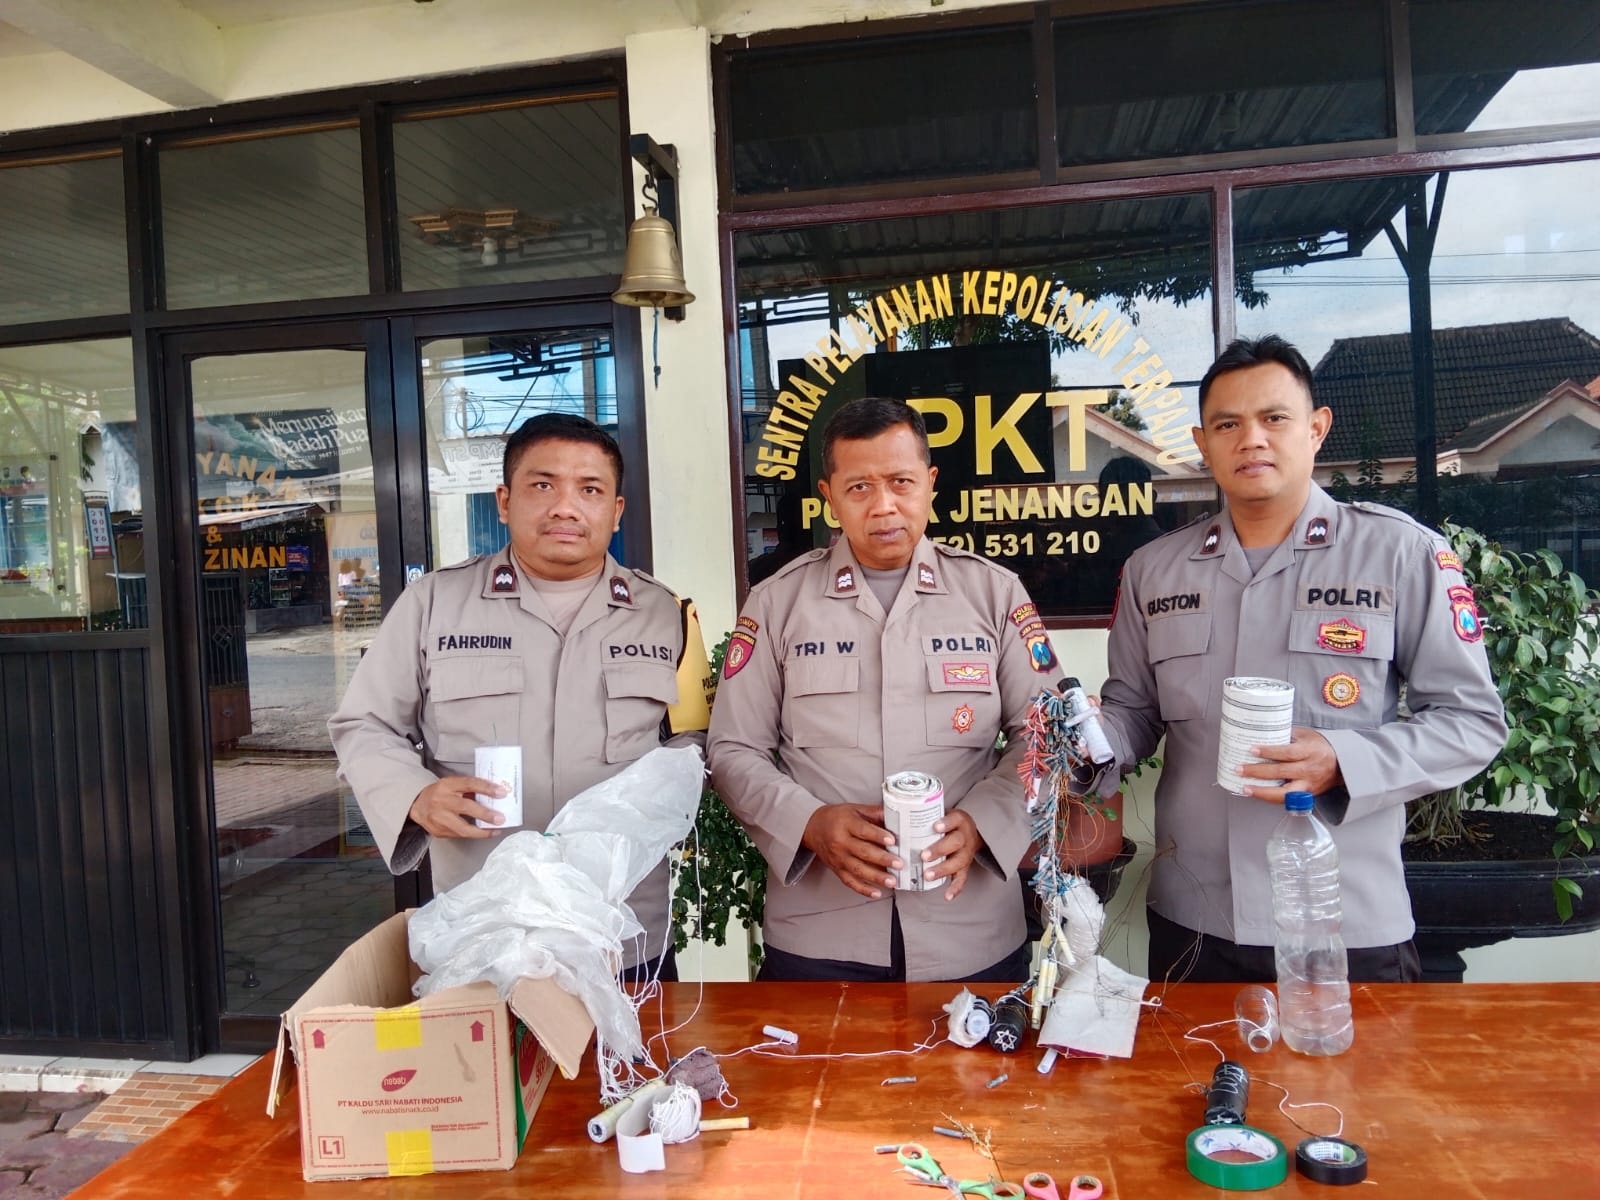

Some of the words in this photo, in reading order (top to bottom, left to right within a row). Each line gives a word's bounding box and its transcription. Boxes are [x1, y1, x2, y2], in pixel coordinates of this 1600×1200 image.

[755, 375, 828, 481] SENTRA
[803, 274, 954, 385] PELAYANAN
[963, 271, 1130, 360] KEPOLISIAN
[1112, 337, 1204, 466] TERPADU
[906, 388, 1108, 475] PKT
[950, 482, 1153, 523] JENANGAN
[984, 532, 1034, 557] 531
[1046, 530, 1100, 556] 210
[205, 546, 286, 570] ZINAN
[1307, 588, 1381, 609] POLRI
[438, 635, 512, 651] FAHRUDIN
[795, 641, 824, 657] TRI
[837, 640, 855, 654] W
[931, 636, 991, 653] POLRI
[609, 644, 673, 662] POLISI
[348, 1099, 374, 1107] KALDU
[375, 1098, 392, 1106] SARI
[393, 1097, 421, 1106] NABATI
[421, 1095, 464, 1105] INDONESIA
[321, 1140, 342, 1156] L1
